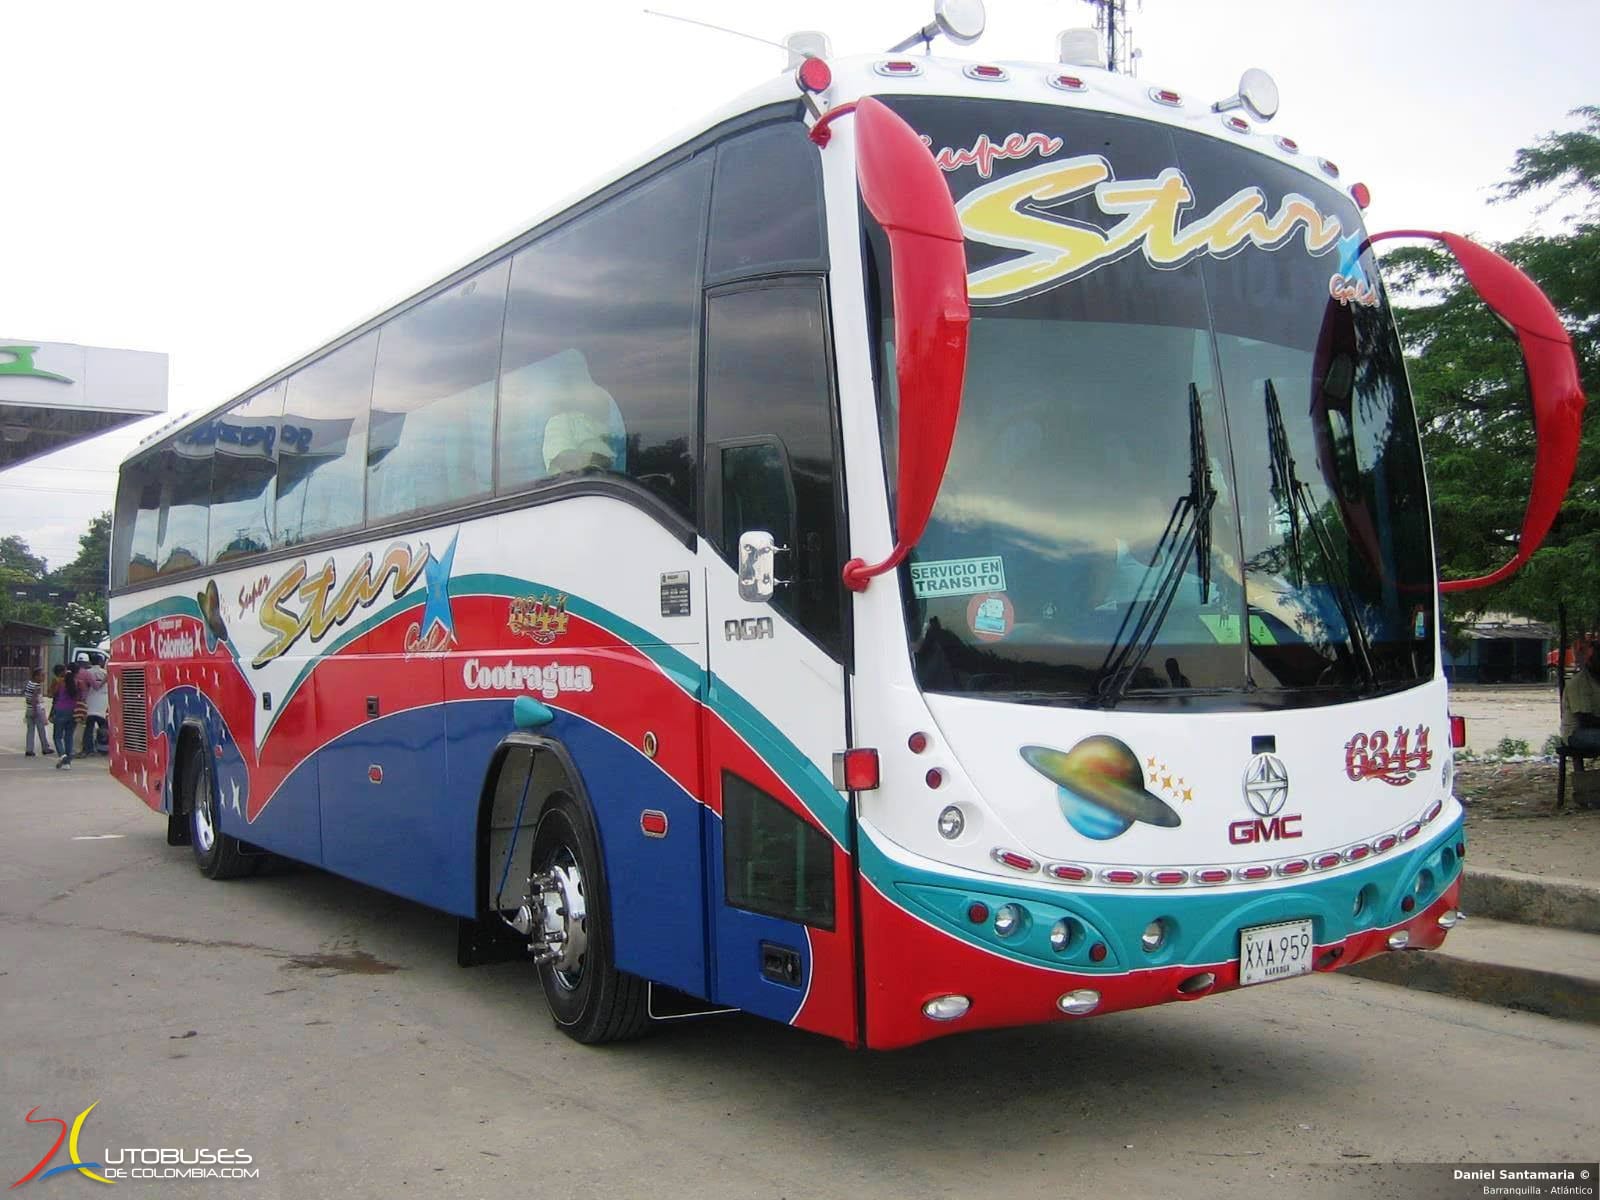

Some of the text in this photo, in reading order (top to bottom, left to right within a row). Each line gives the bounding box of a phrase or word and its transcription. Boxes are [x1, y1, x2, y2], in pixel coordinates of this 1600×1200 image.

[919, 132, 1064, 179] uper
[955, 154, 1343, 304] Star
[911, 562, 999, 580] SERVICIO EN
[915, 575, 1000, 592] TRANSITO
[238, 541, 431, 670] Super Star
[158, 631, 194, 659] Colombia
[724, 616, 774, 641] AGA
[463, 658, 594, 699] Cootragua
[1345, 724, 1433, 784] 6344
[1228, 814, 1303, 845] GMC
[1245, 933, 1310, 970] XXA 959
